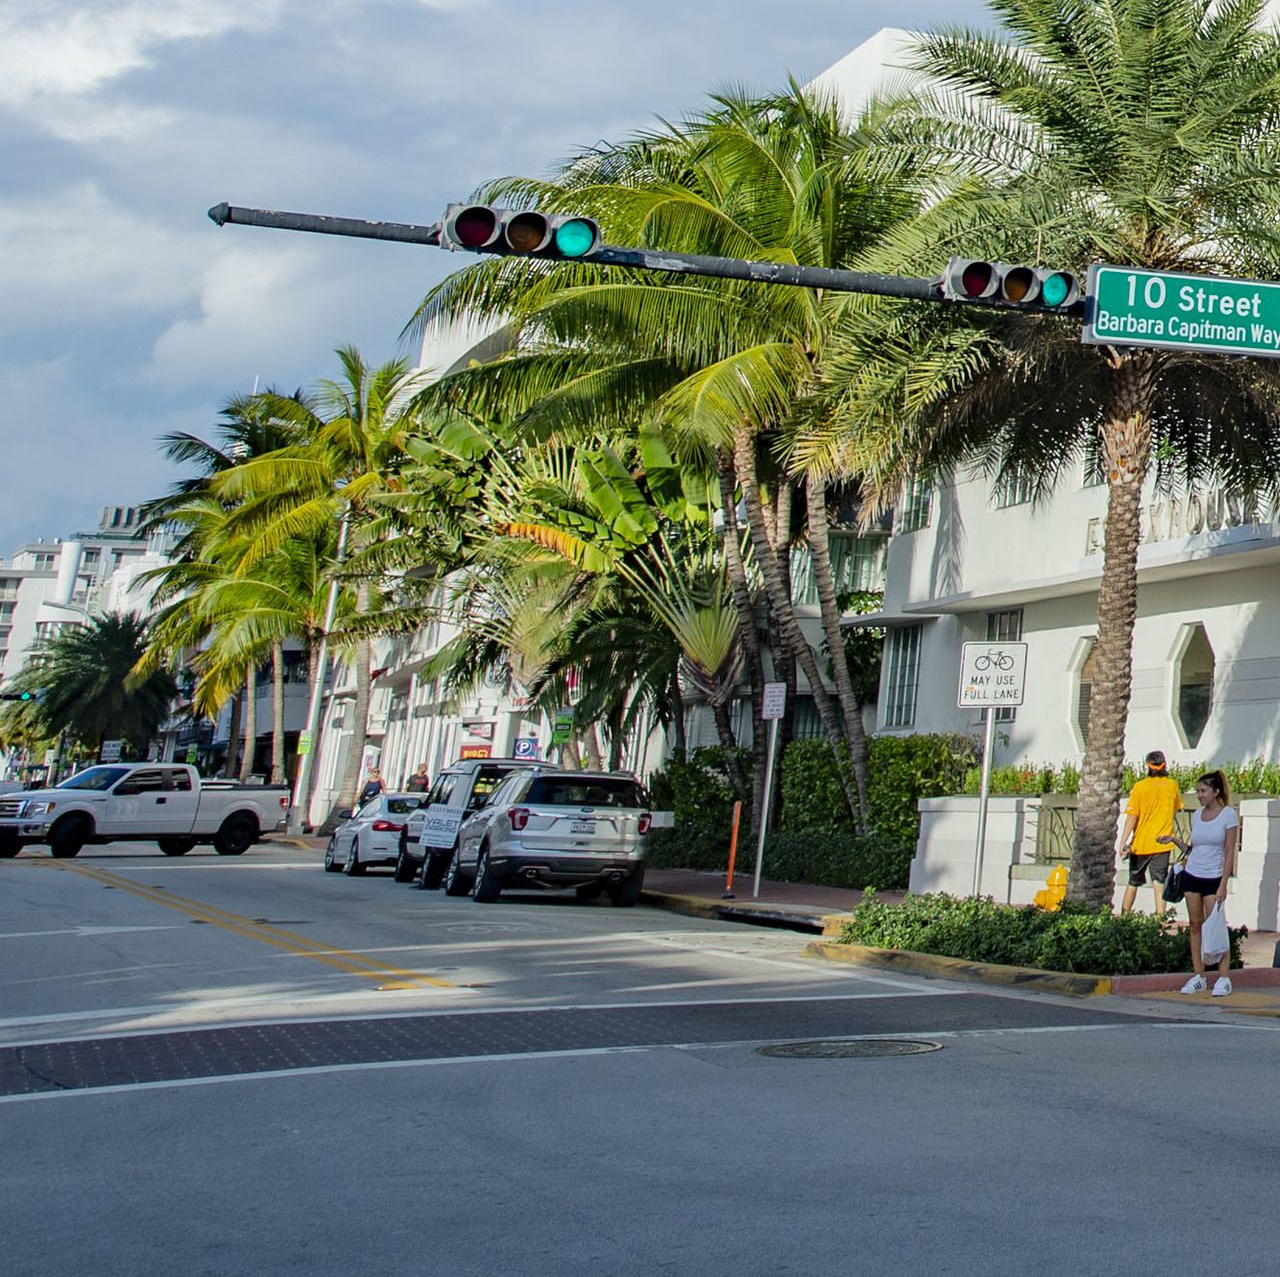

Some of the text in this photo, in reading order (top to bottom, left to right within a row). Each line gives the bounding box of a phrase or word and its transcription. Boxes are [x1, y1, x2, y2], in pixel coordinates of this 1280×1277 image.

[1127, 274, 1262, 318] 10 Street
[1097, 310, 1164, 336] Barbara
[1167, 317, 1246, 342] Capitman
[970, 675, 1016, 686] MAY USE
[964, 689, 1019, 700] FULL LANE
